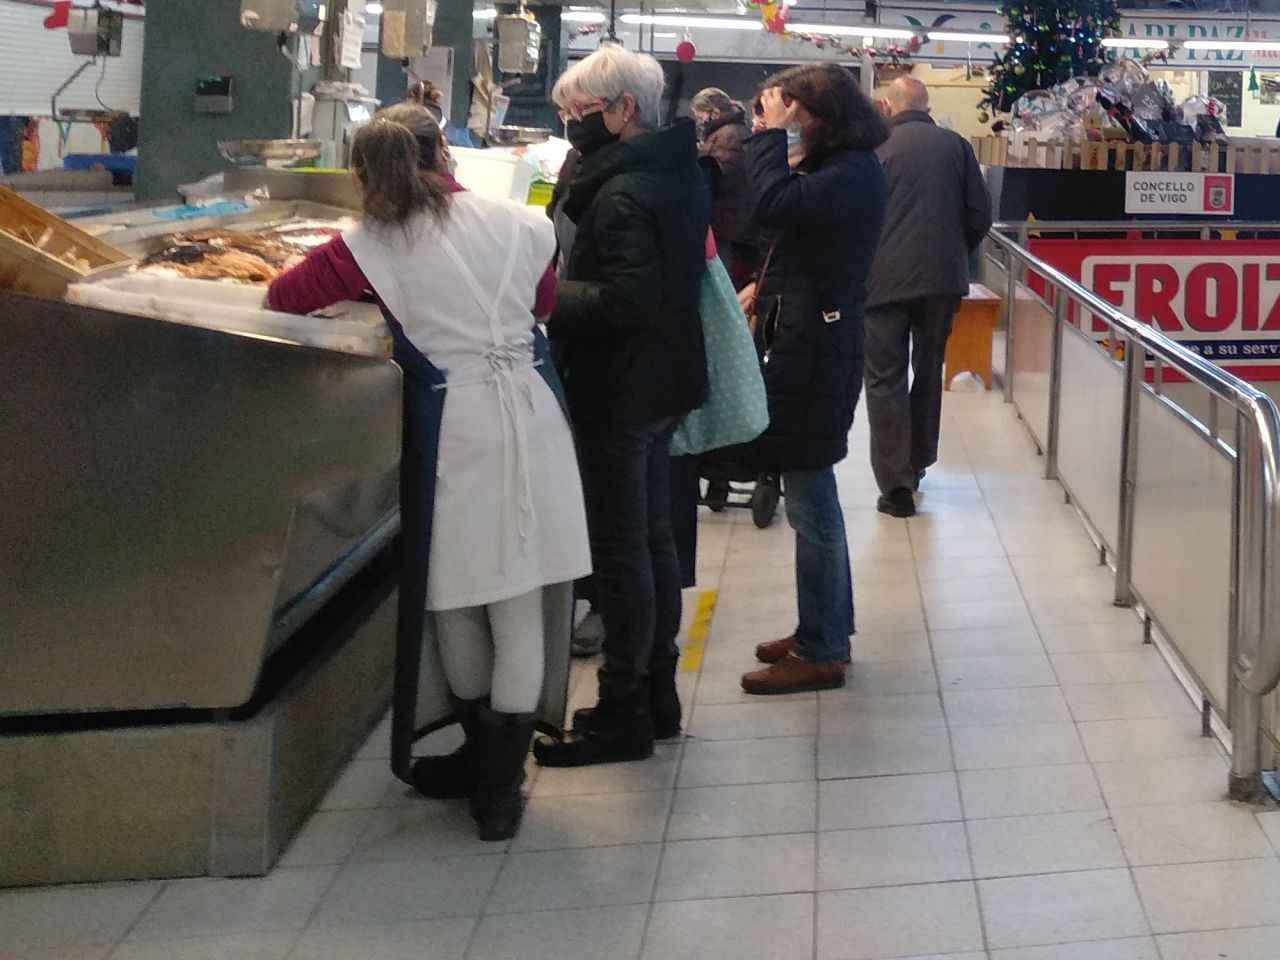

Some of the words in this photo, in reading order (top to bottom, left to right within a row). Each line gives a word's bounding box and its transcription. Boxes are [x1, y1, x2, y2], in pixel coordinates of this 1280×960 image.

[1187, 24, 1244, 60] PAZ
[1133, 181, 1195, 192] CONCELLO
[1140, 193, 1156, 203] DE
[1159, 193, 1188, 203] VIGO
[1203, 344, 1214, 355] a
[1218, 343, 1244, 355] su
